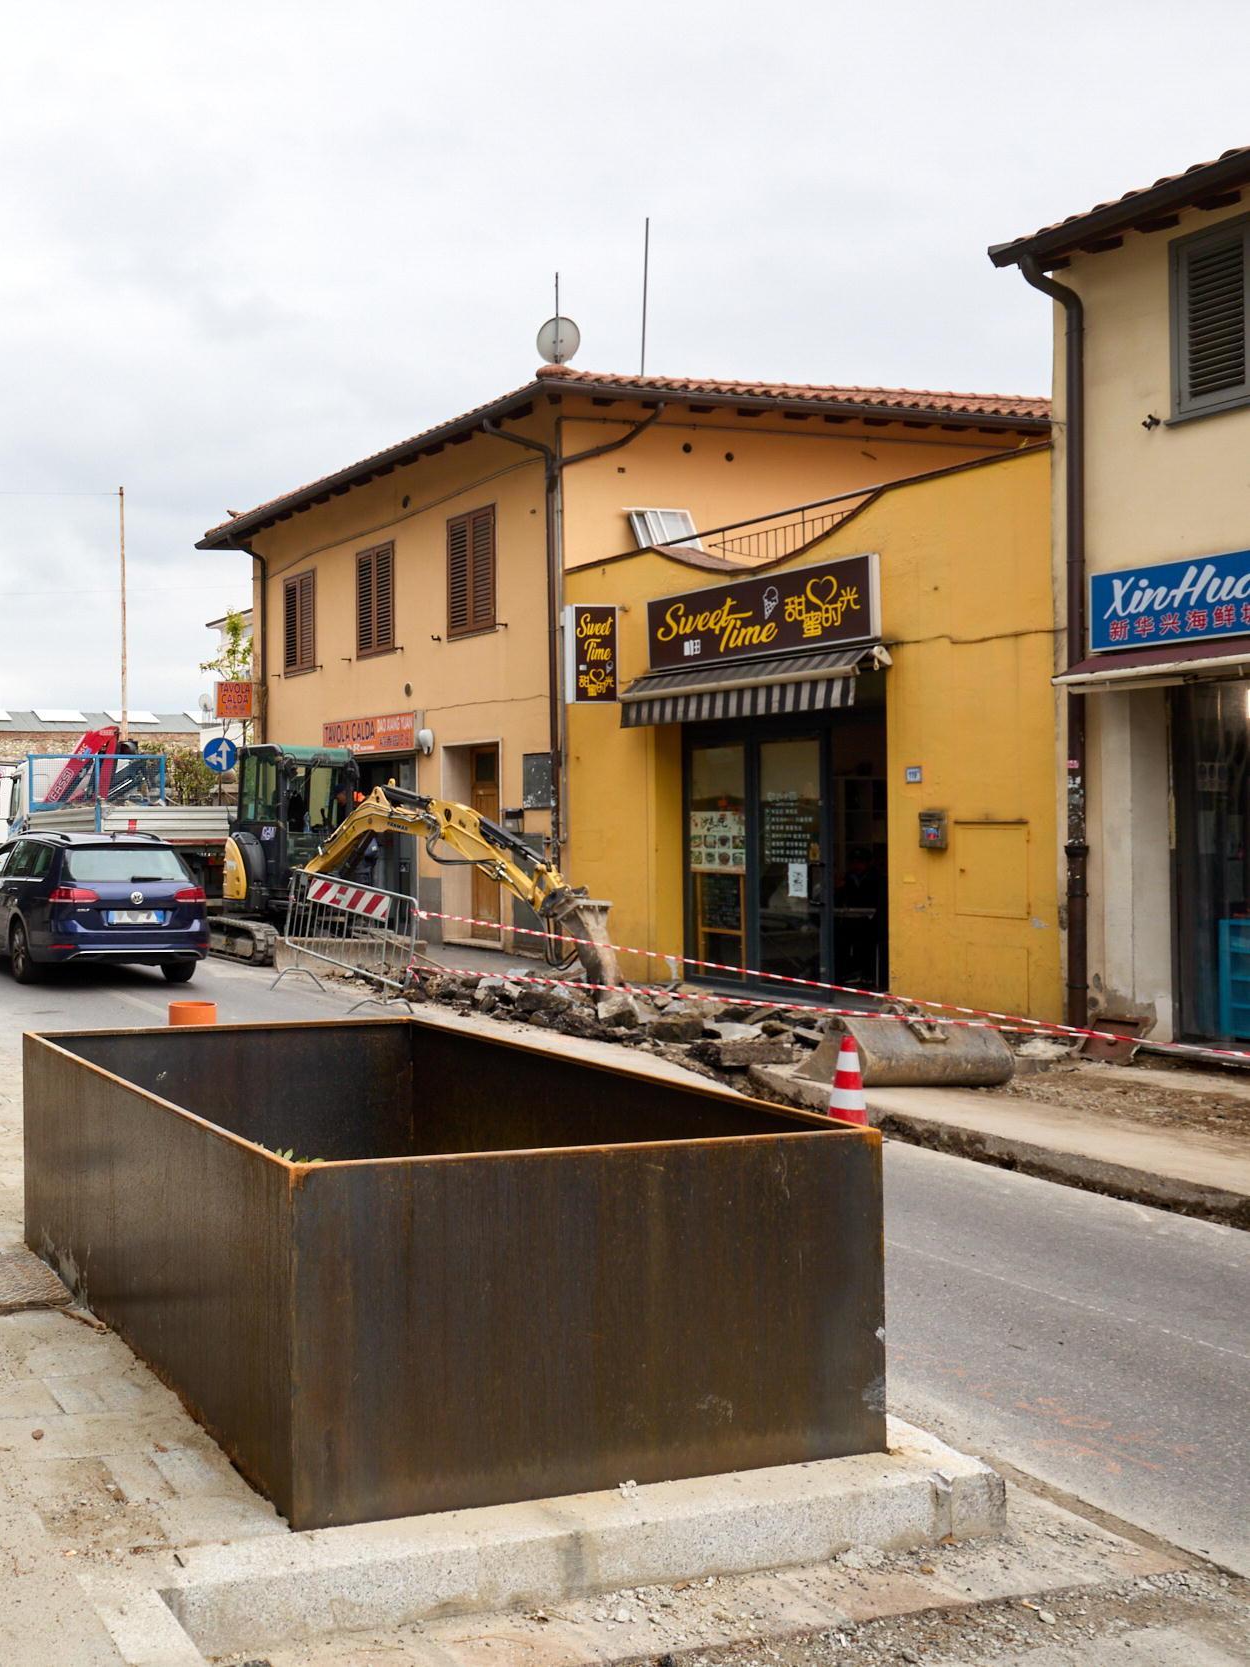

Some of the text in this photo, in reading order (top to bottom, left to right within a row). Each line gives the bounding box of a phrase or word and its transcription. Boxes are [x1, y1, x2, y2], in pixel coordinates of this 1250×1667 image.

[576, 613, 614, 638] Sweet
[656, 597, 737, 642] Sweet
[714, 611, 779, 653] Time
[584, 638, 612, 662] Time
[220, 683, 251, 694] TAVOLA
[221, 694, 249, 705] CALDA
[324, 723, 350, 744] TAVOLA
[351, 720, 375, 742] CALDA
[51, 769, 73, 801] FASSI
